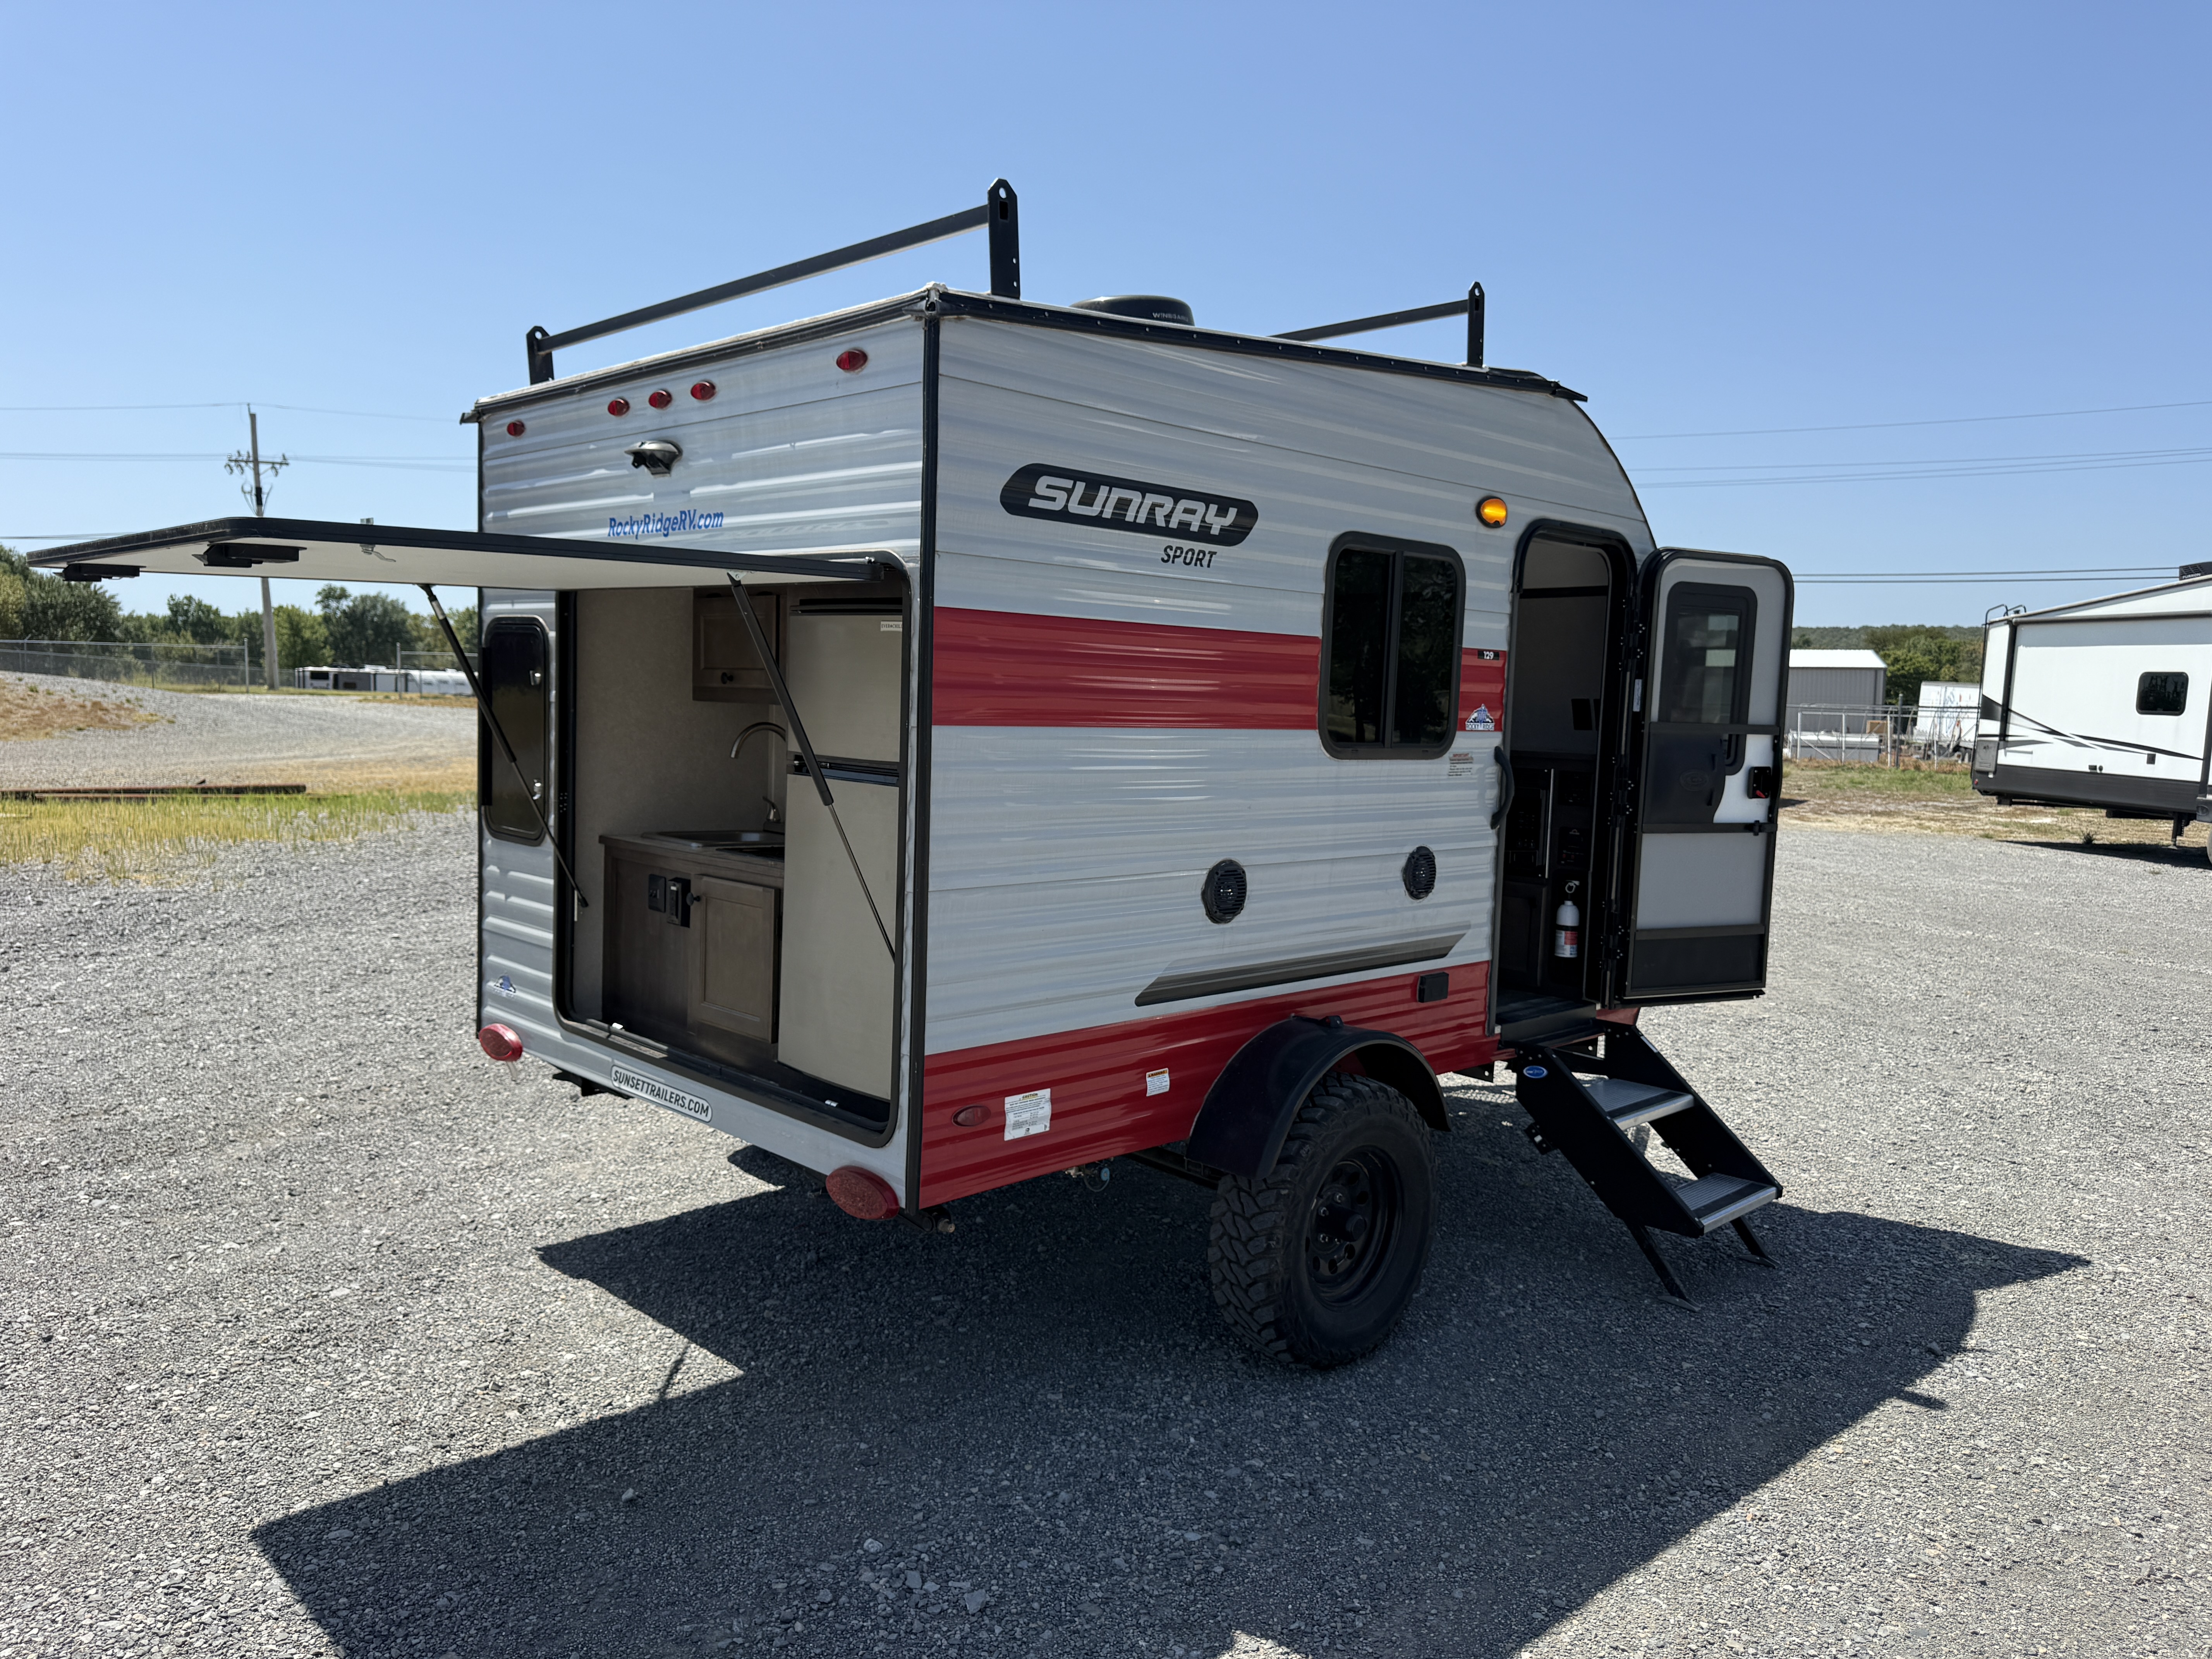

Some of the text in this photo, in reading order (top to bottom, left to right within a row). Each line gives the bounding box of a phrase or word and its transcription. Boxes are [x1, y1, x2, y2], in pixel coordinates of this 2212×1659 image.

[1028, 475, 1238, 536] SUNRAY
[608, 509, 724, 540] RockyRidgeRV.com
[1161, 545, 1217, 568] SPORT
[1483, 651, 1494, 659] 129
[613, 1070, 710, 1118] SUNSETTRAILERS.COM
